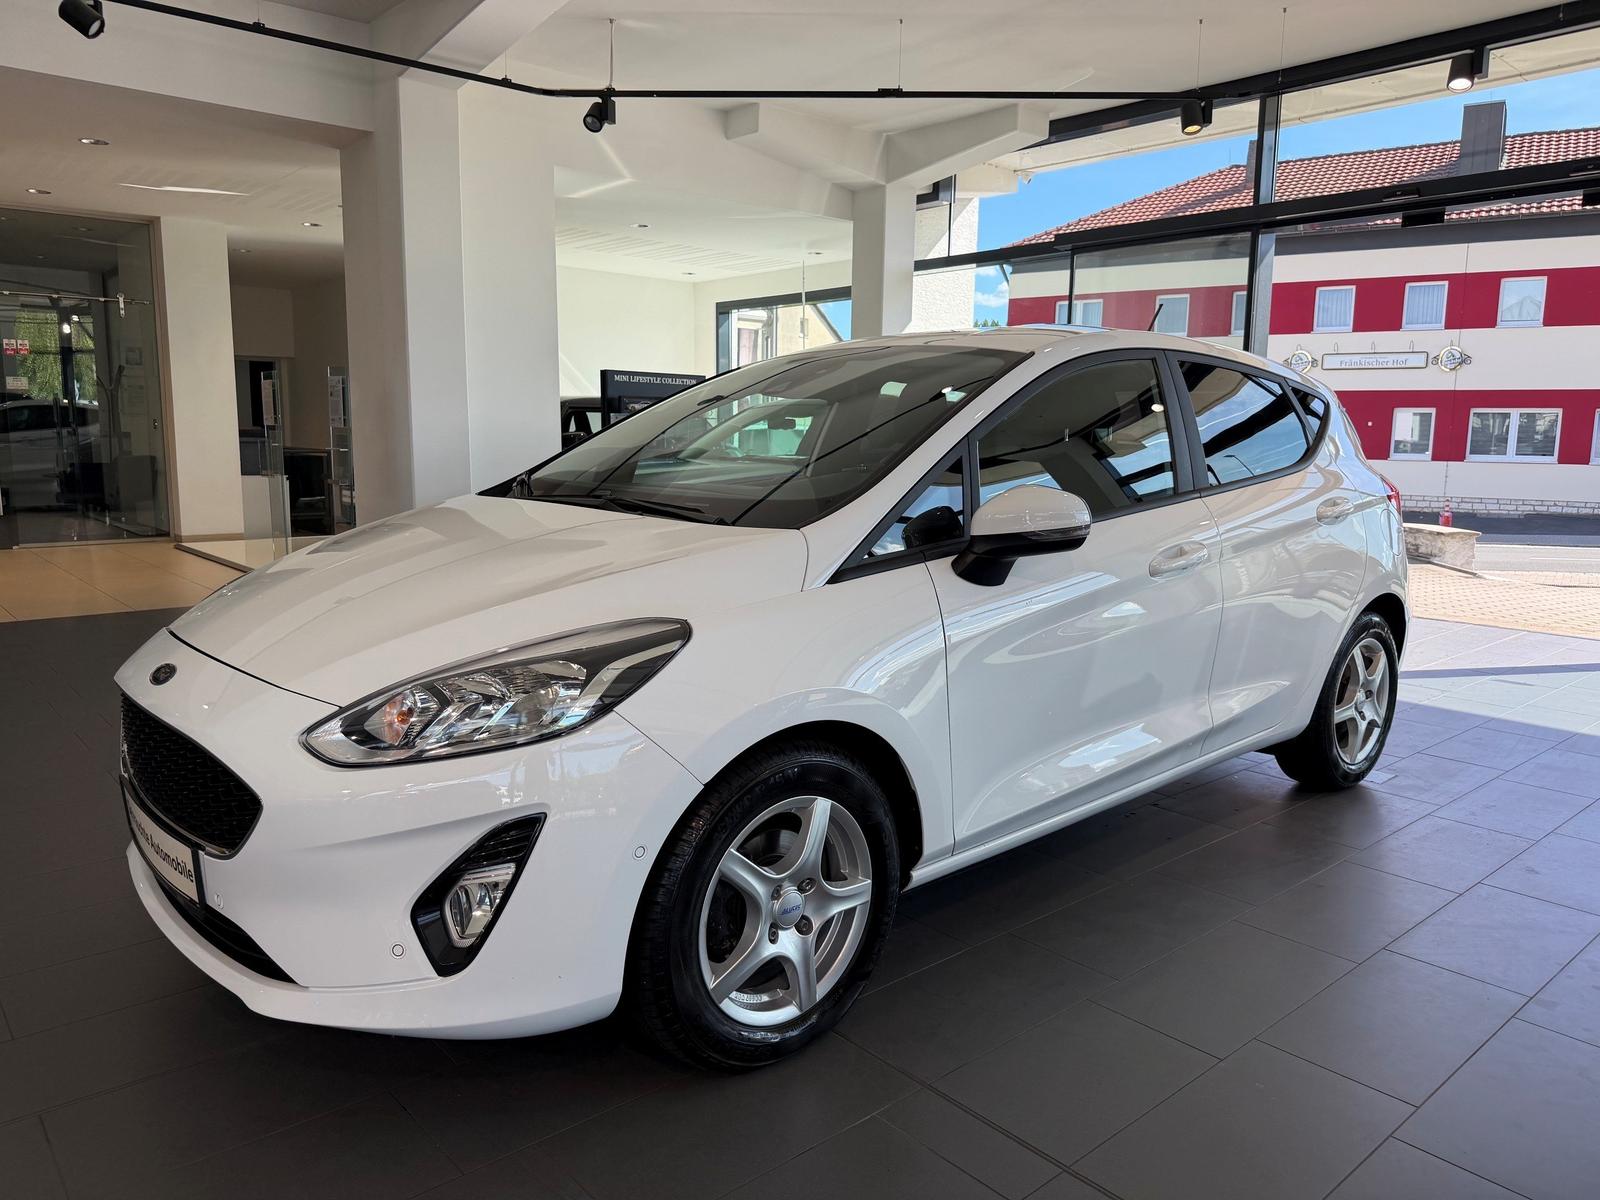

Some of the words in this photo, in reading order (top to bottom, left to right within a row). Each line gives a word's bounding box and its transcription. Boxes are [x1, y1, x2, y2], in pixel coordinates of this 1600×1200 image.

[1340, 358, 1389, 367] Fränkischer
[1392, 358, 1408, 366] Hof
[614, 374, 629, 382] MINI
[630, 376, 661, 384] LIFESTYLE
[662, 377, 697, 386] COLLECTION
[150, 834, 194, 883] Automobile
